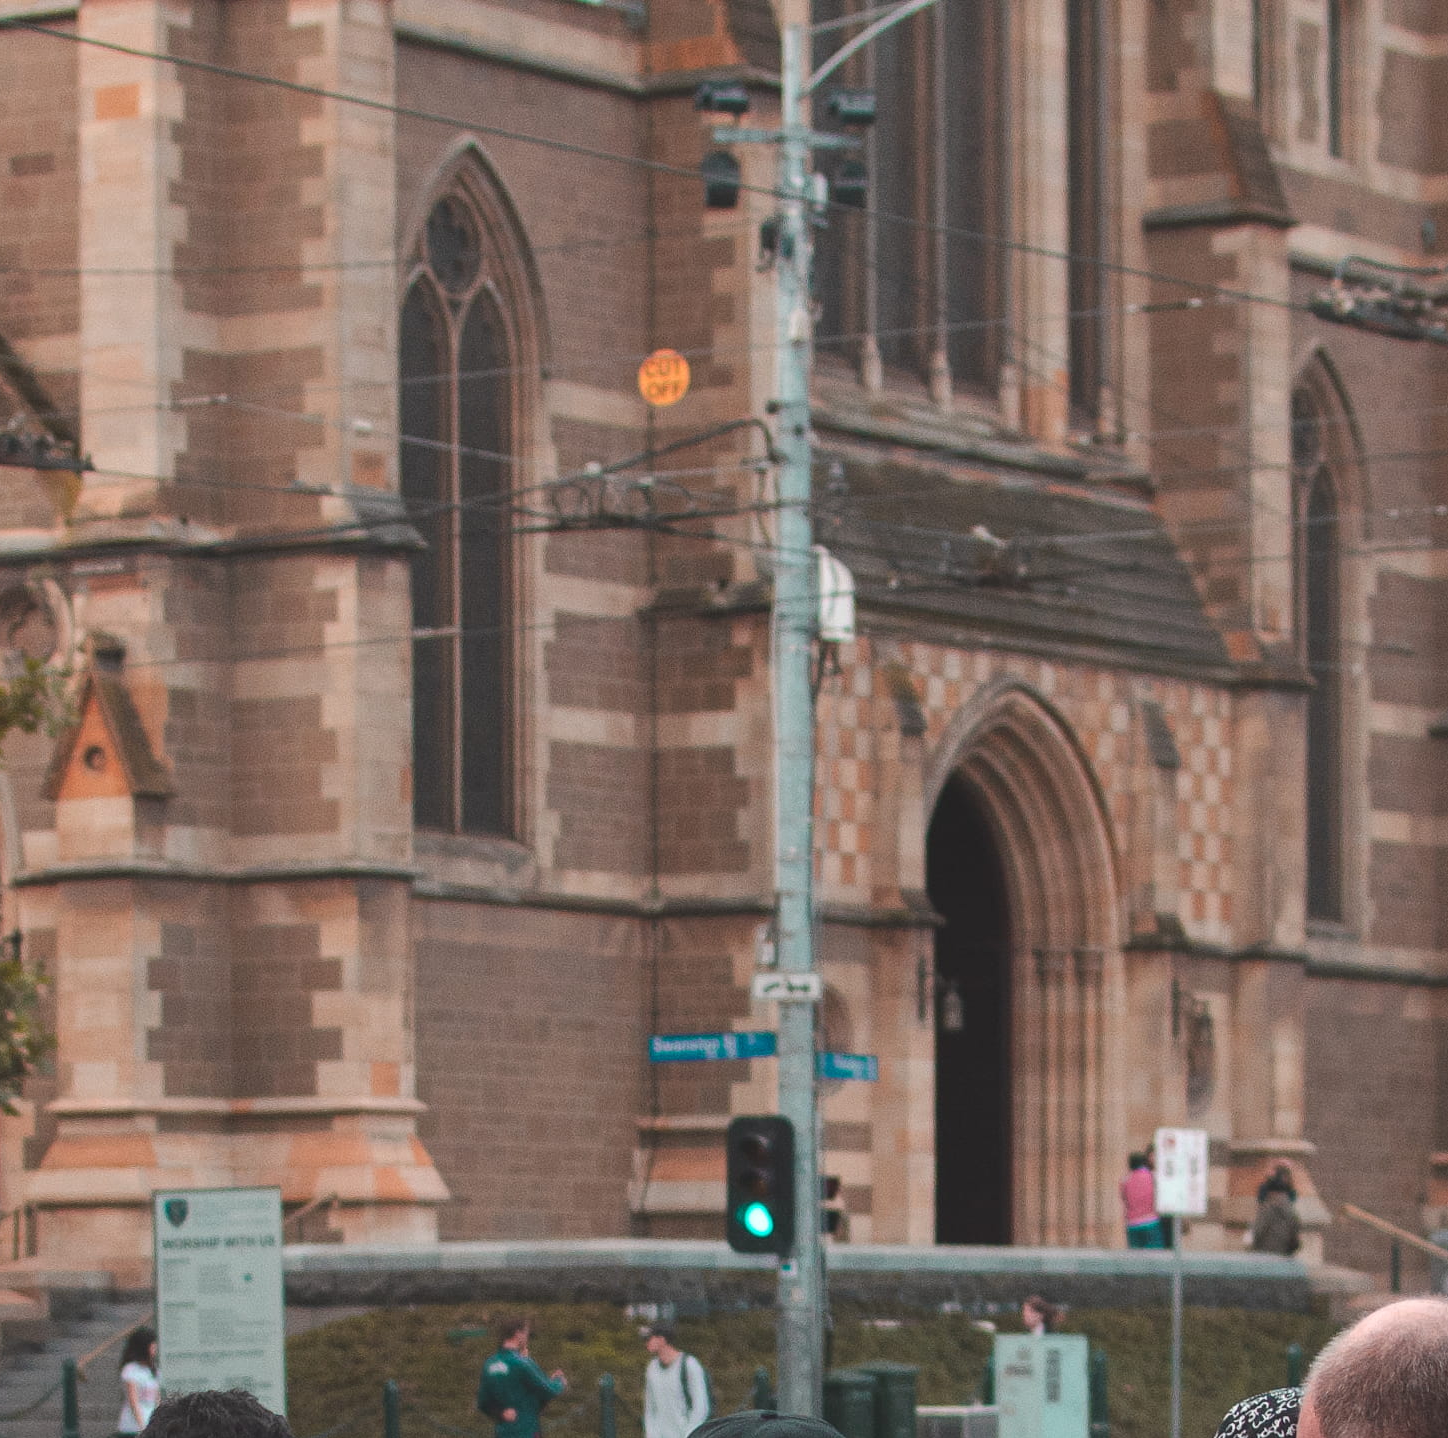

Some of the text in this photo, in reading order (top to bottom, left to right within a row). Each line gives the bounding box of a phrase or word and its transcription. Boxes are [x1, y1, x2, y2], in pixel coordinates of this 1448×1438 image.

[646, 359, 681, 376] CUT
[162, 1234, 275, 1249] WORSHIP WITH US
